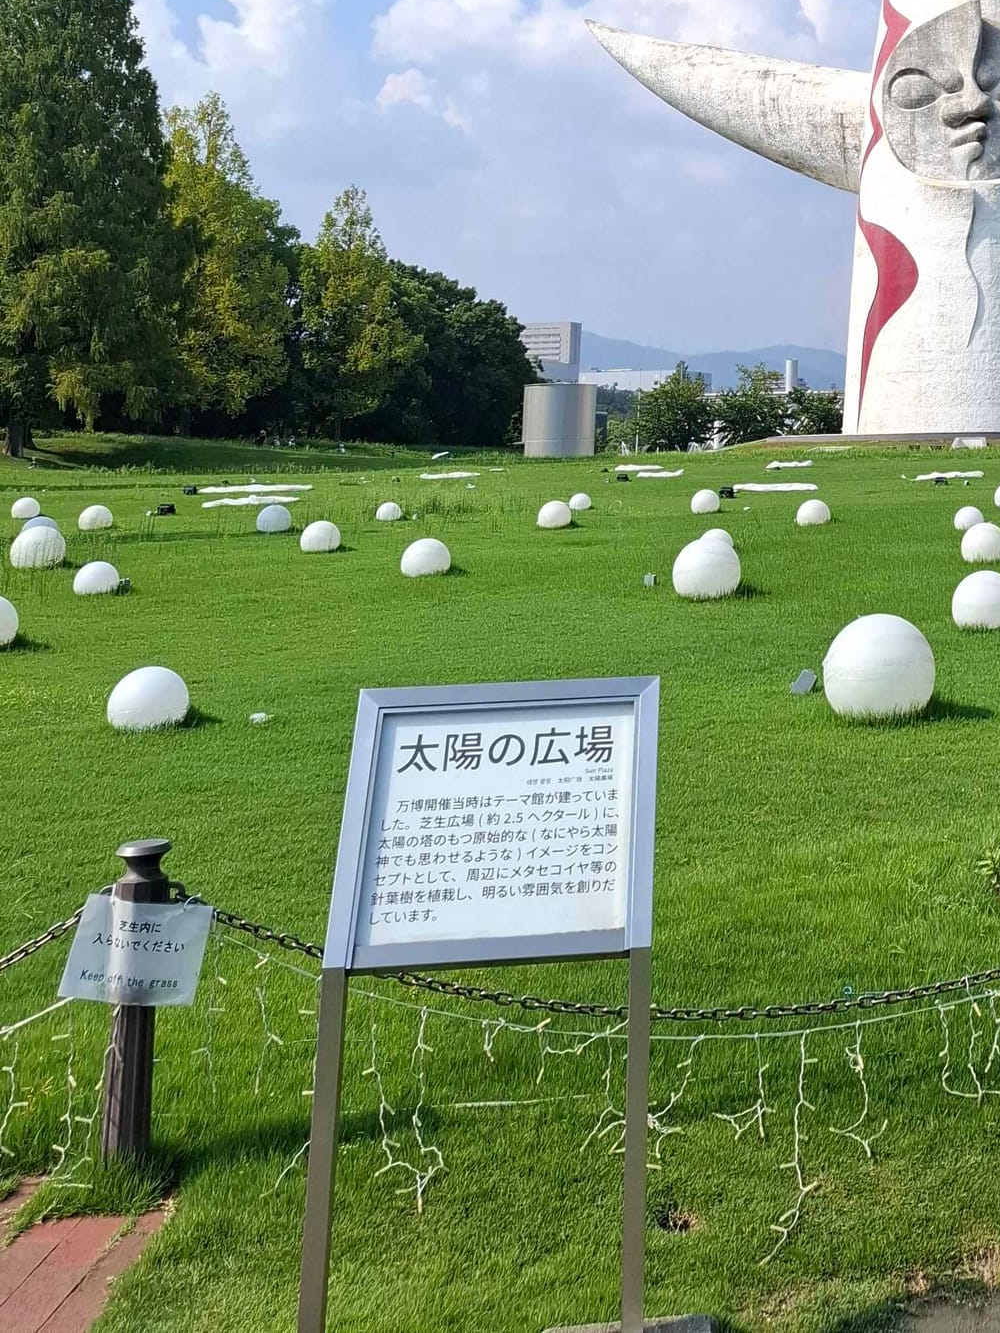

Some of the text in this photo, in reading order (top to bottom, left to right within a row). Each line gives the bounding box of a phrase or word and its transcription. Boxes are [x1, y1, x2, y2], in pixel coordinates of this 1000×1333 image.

[397, 725, 615, 773] 太陽の広場
[396, 788, 619, 813] 万博開催当時はテーマ館が建っていま
[373, 861, 617, 887] セプトとして、周辺にメタセコイヤ等の
[370, 878, 615, 907] 針葉樹を植栽し、明るい雰囲気を創りだ
[119, 920, 162, 934] 芝生内に
[369, 908, 438, 926] しています。
[92, 932, 185, 953] 入らないでください
[79, 969, 105, 983] Keep
[127, 975, 144, 987] the
[149, 979, 178, 990] grass
